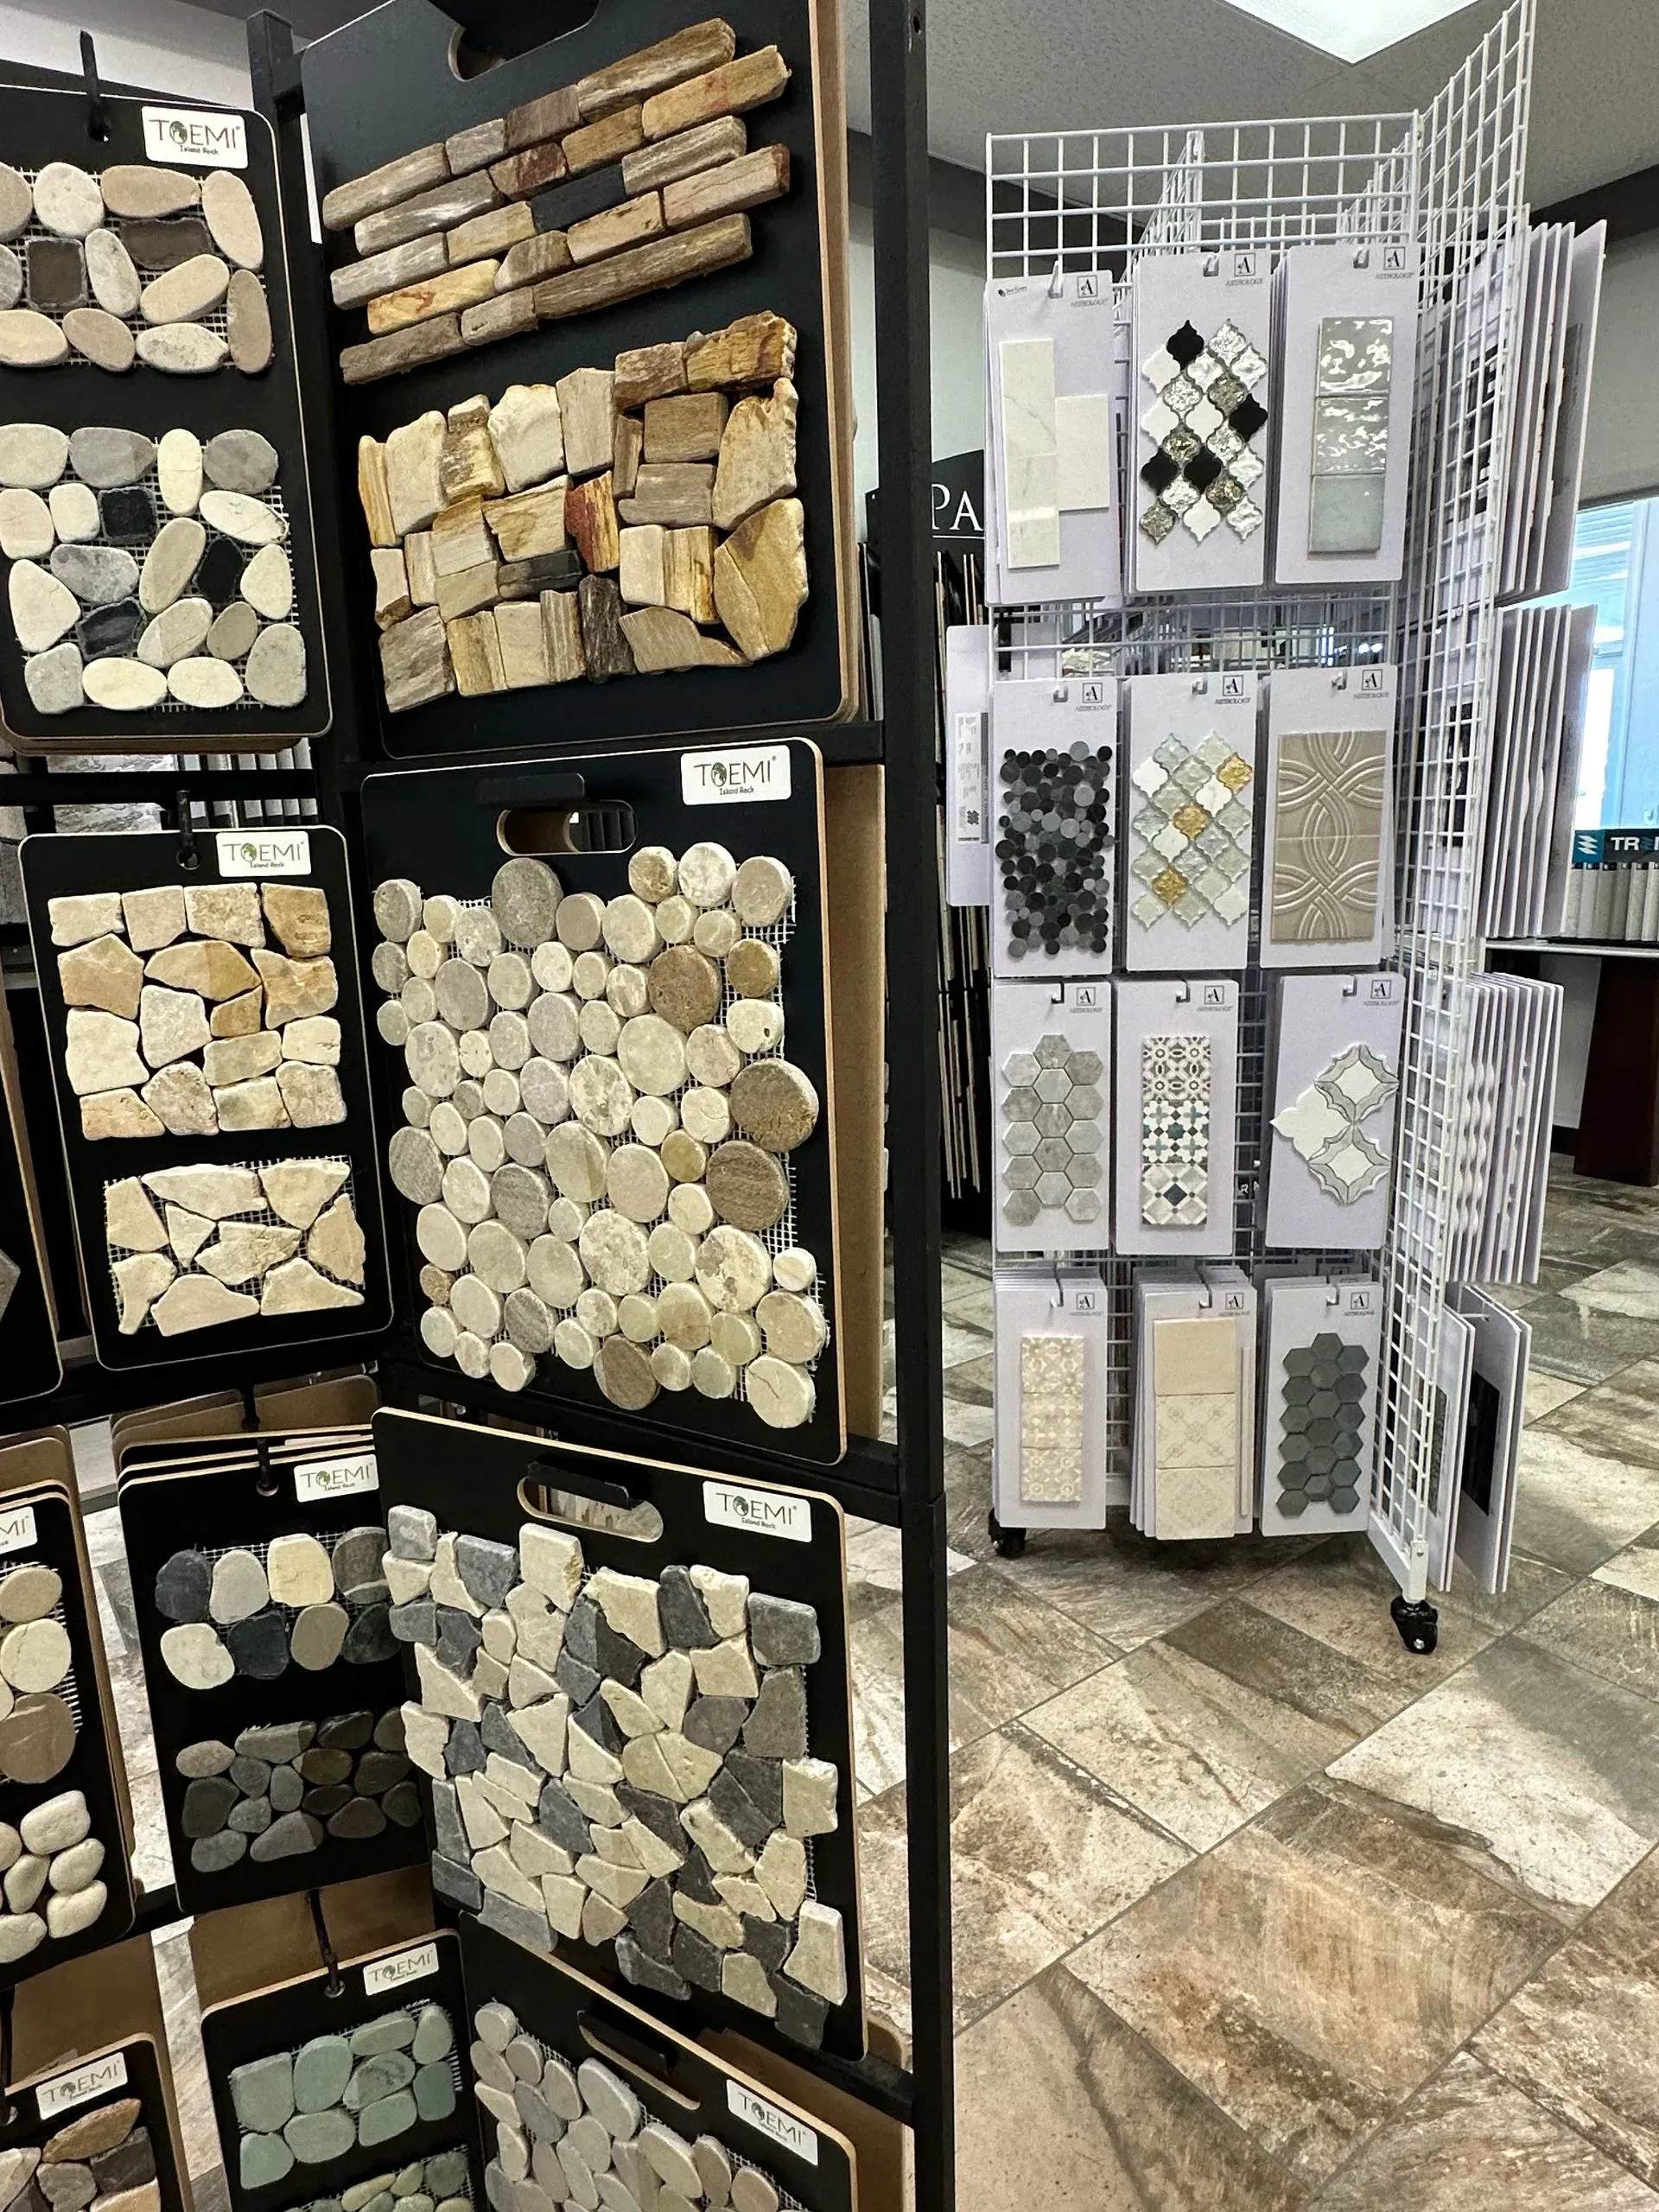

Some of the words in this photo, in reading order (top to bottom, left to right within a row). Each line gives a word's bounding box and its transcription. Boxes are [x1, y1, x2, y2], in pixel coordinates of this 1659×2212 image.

[149, 119, 237, 149] TOEMI
[694, 760, 772, 787] TOEMI
[719, 787, 738, 796] Island
[740, 786, 754, 795] Rock
[222, 843, 301, 862] TOEMI
[299, 1465, 371, 1488] TOEMI
[715, 1493, 791, 1523] TOEMI
[741, 1517, 760, 1527] Island
[368, 1954, 430, 1981] TOEMI
[44, 2066, 119, 2101] TOEMI
[738, 2090, 802, 2145] TOEMI
